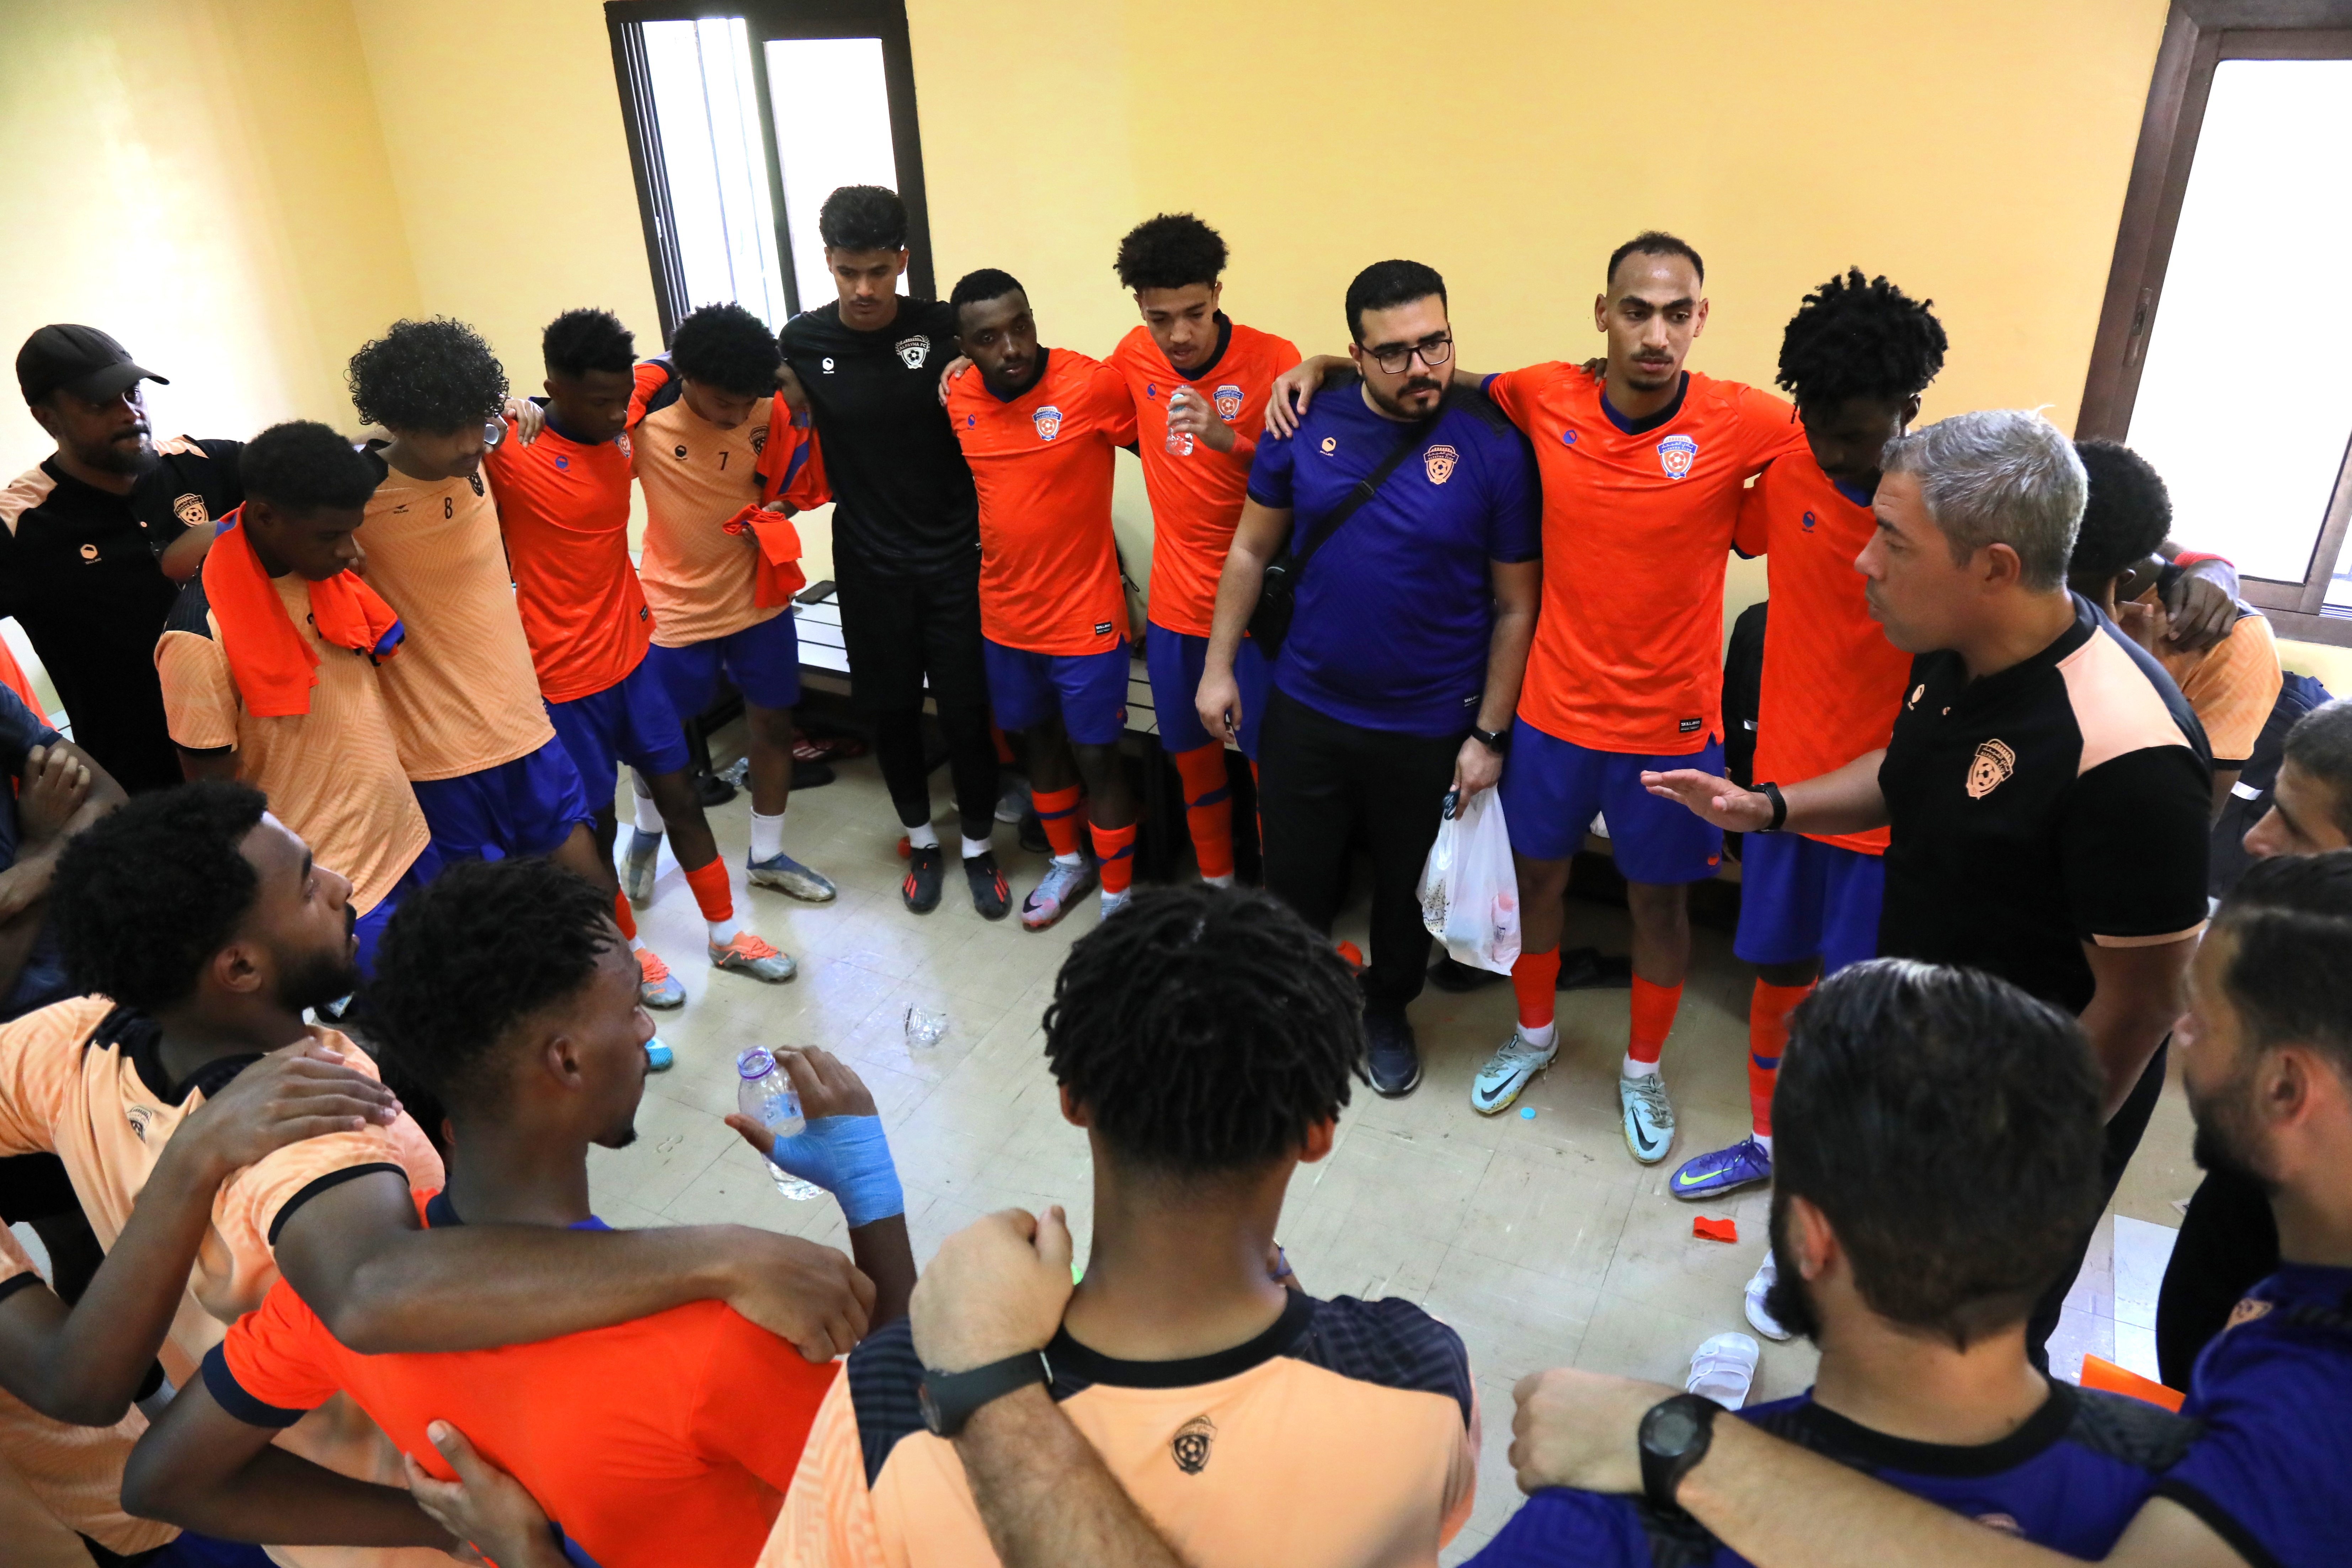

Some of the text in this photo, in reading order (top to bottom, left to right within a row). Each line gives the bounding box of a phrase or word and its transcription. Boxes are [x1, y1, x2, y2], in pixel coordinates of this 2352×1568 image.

[899, 342, 919, 350] ALFAYHA
[719, 452, 729, 470] 7
[444, 497, 453, 519] 8
